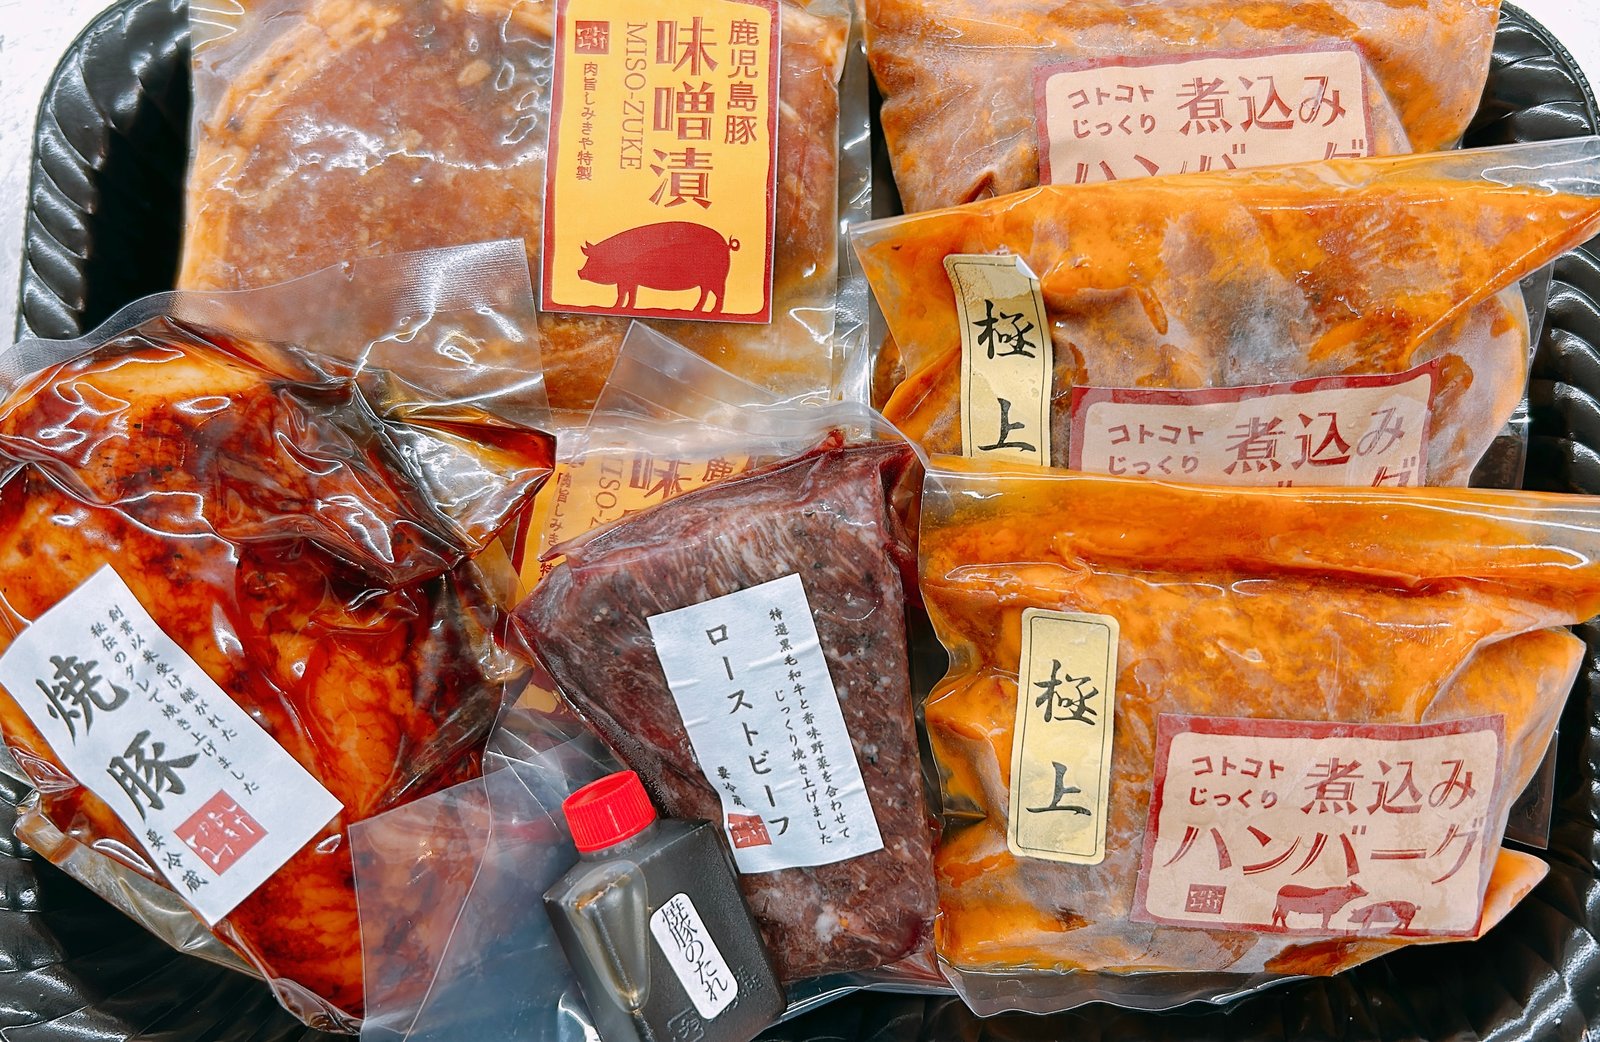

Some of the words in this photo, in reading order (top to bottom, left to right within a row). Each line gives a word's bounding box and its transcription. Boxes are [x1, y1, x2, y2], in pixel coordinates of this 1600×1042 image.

[576, 62, 598, 181] 肉旨しみきや特製
[620, 22, 648, 170] MISO-ZUKE
[648, 16, 719, 210] 味噌漬
[724, 18, 760, 145] 鹿児島豚
[1067, 84, 1155, 110] コトコト
[1072, 113, 1156, 139] じっくり
[1175, 75, 1347, 136] 煮込み
[972, 299, 1037, 454] 極上
[1107, 423, 1205, 446] コトコト
[1108, 453, 1200, 476] じっくり
[1222, 406, 1405, 476] 煮込み
[109, 604, 238, 742] 創業以来受け継がれた
[35, 655, 200, 822] 焼豚
[705, 623, 789, 836] ローストビーフ
[769, 607, 850, 838] 特選黒毛和牛と香味野菜を合わせて
[775, 689, 833, 845] じっくり焼き上げました
[1025, 658, 1100, 817] 極上
[1191, 755, 1285, 779] コトコト
[1189, 787, 1279, 809] じっくり
[1300, 756, 1476, 817] 煮込み
[146, 829, 209, 895] 要冷蔵
[1163, 816, 1486, 885] ハンバーグ
